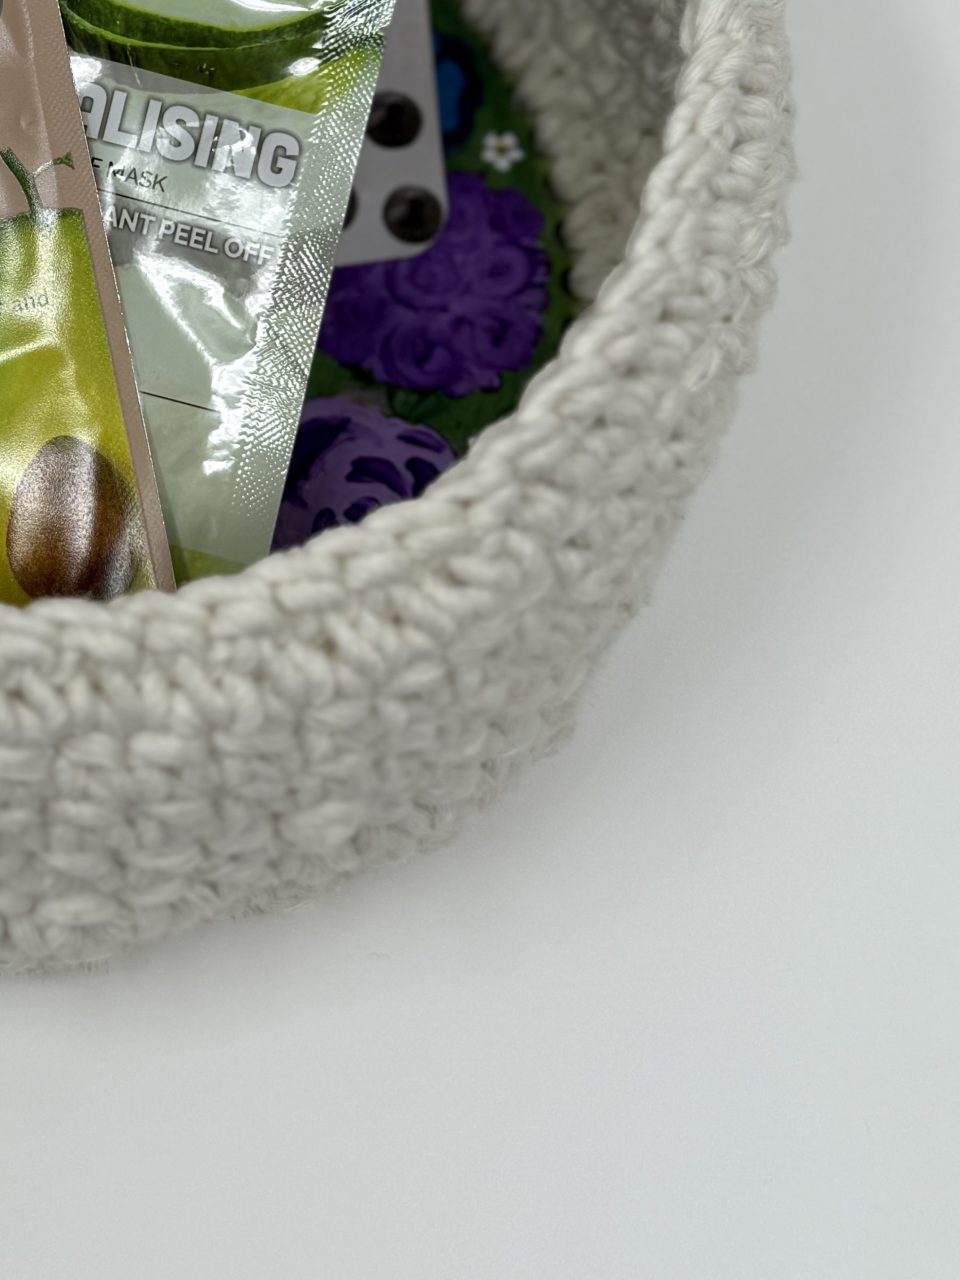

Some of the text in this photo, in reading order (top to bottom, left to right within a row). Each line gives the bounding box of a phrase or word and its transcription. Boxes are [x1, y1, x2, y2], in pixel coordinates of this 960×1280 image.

[157, 218, 219, 255] PEEL
[223, 236, 275, 266] OFF
[12, 289, 50, 313] and
